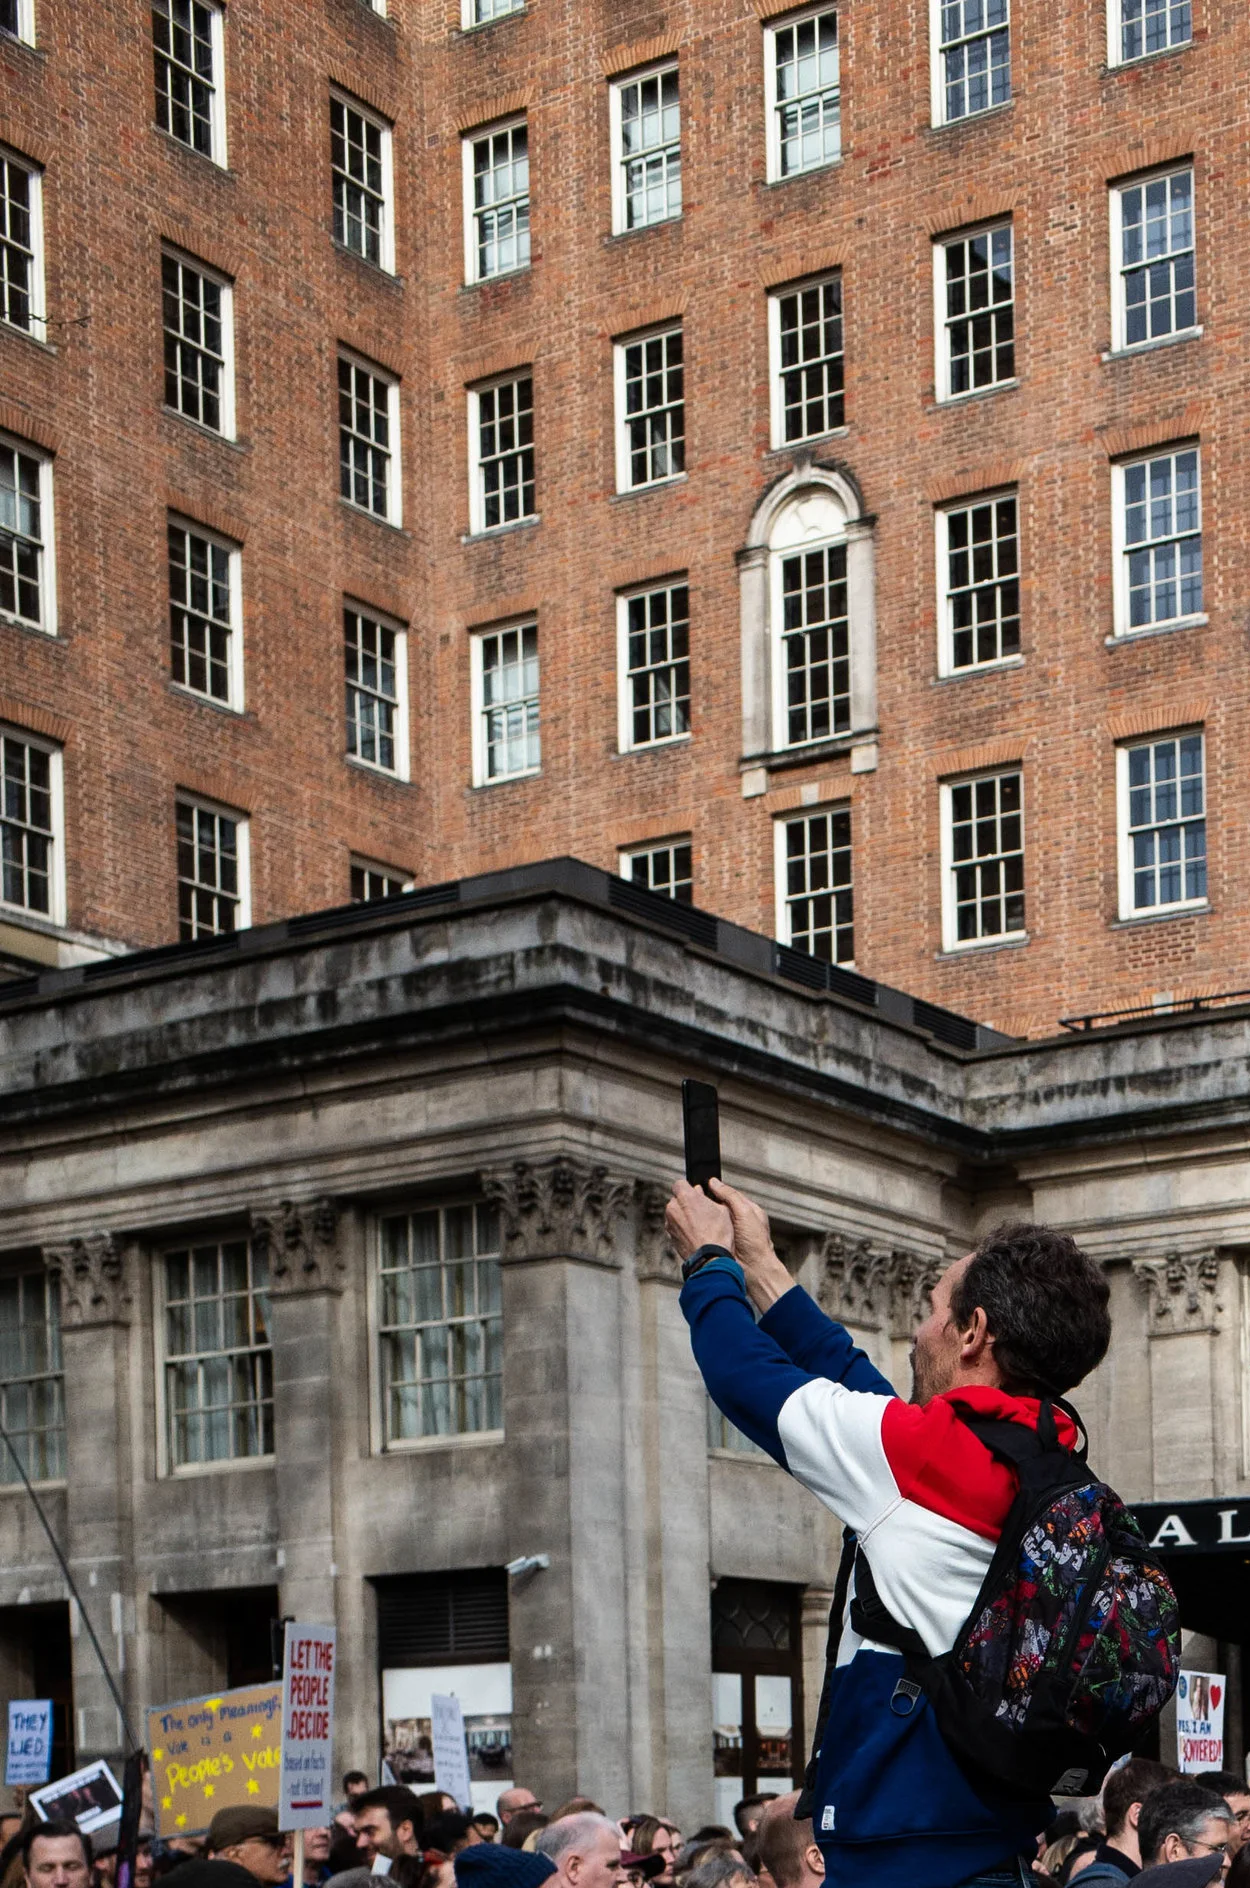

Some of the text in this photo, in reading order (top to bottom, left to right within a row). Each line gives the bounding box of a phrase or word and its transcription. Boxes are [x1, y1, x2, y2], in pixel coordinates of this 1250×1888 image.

[291, 1640, 333, 1672] LET THE
[290, 1674, 328, 1706] PEOPLE
[13, 1711, 47, 1732] THEY
[160, 1714, 184, 1733] The
[188, 1711, 214, 1731] only
[291, 1710, 329, 1740] DECIDE
[10, 1737, 44, 1756] LIED
[166, 1751, 234, 1795] People's
